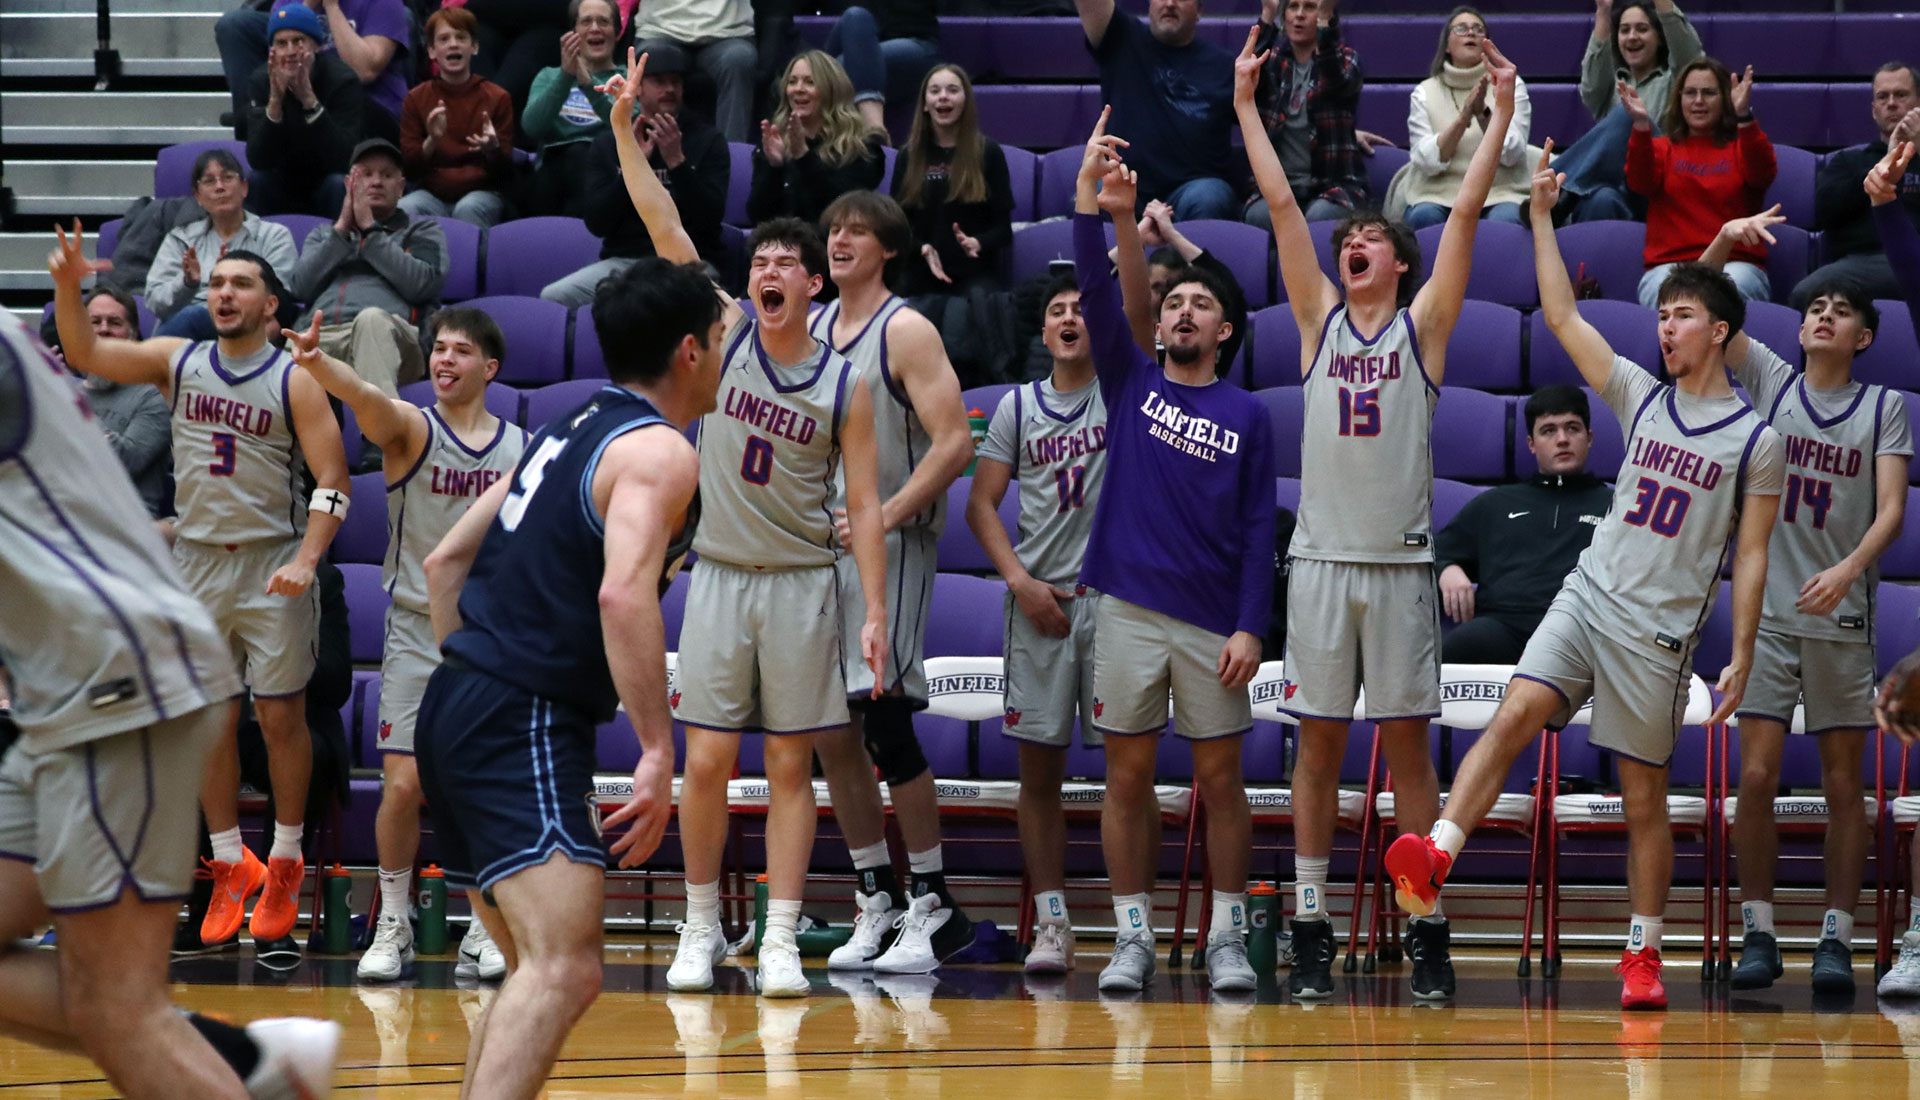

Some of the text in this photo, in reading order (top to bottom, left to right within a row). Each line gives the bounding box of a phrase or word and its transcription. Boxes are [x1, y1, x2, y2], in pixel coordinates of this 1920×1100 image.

[1327, 349, 1401, 384] LINFIELD
[185, 393, 272, 437] LINFIELD
[724, 386, 817, 446] LINFIELD
[1140, 390, 1240, 456] LINFIELD
[1338, 386, 1382, 437] 15
[209, 432, 237, 477] 3
[740, 434, 775, 488] 0
[1026, 425, 1107, 467] LINFIELD
[1148, 423, 1217, 463] BASKETBALL
[1631, 436, 1723, 492] LINFIELD
[1784, 433, 1863, 478] INFIELD
[431, 465, 502, 498] LINFIE
[1055, 464, 1086, 514] 11
[1783, 472, 1833, 531] 14
[1622, 475, 1692, 539] 30
[926, 675, 1005, 694] LINFIEL
[1440, 683, 1505, 700] NFIEL
[597, 783, 634, 795] LDCA
[936, 785, 979, 798] CATS
[1060, 791, 1106, 801] WILDC
[1249, 795, 1292, 806] ILDCA
[1774, 804, 1829, 815] ILDCAT
